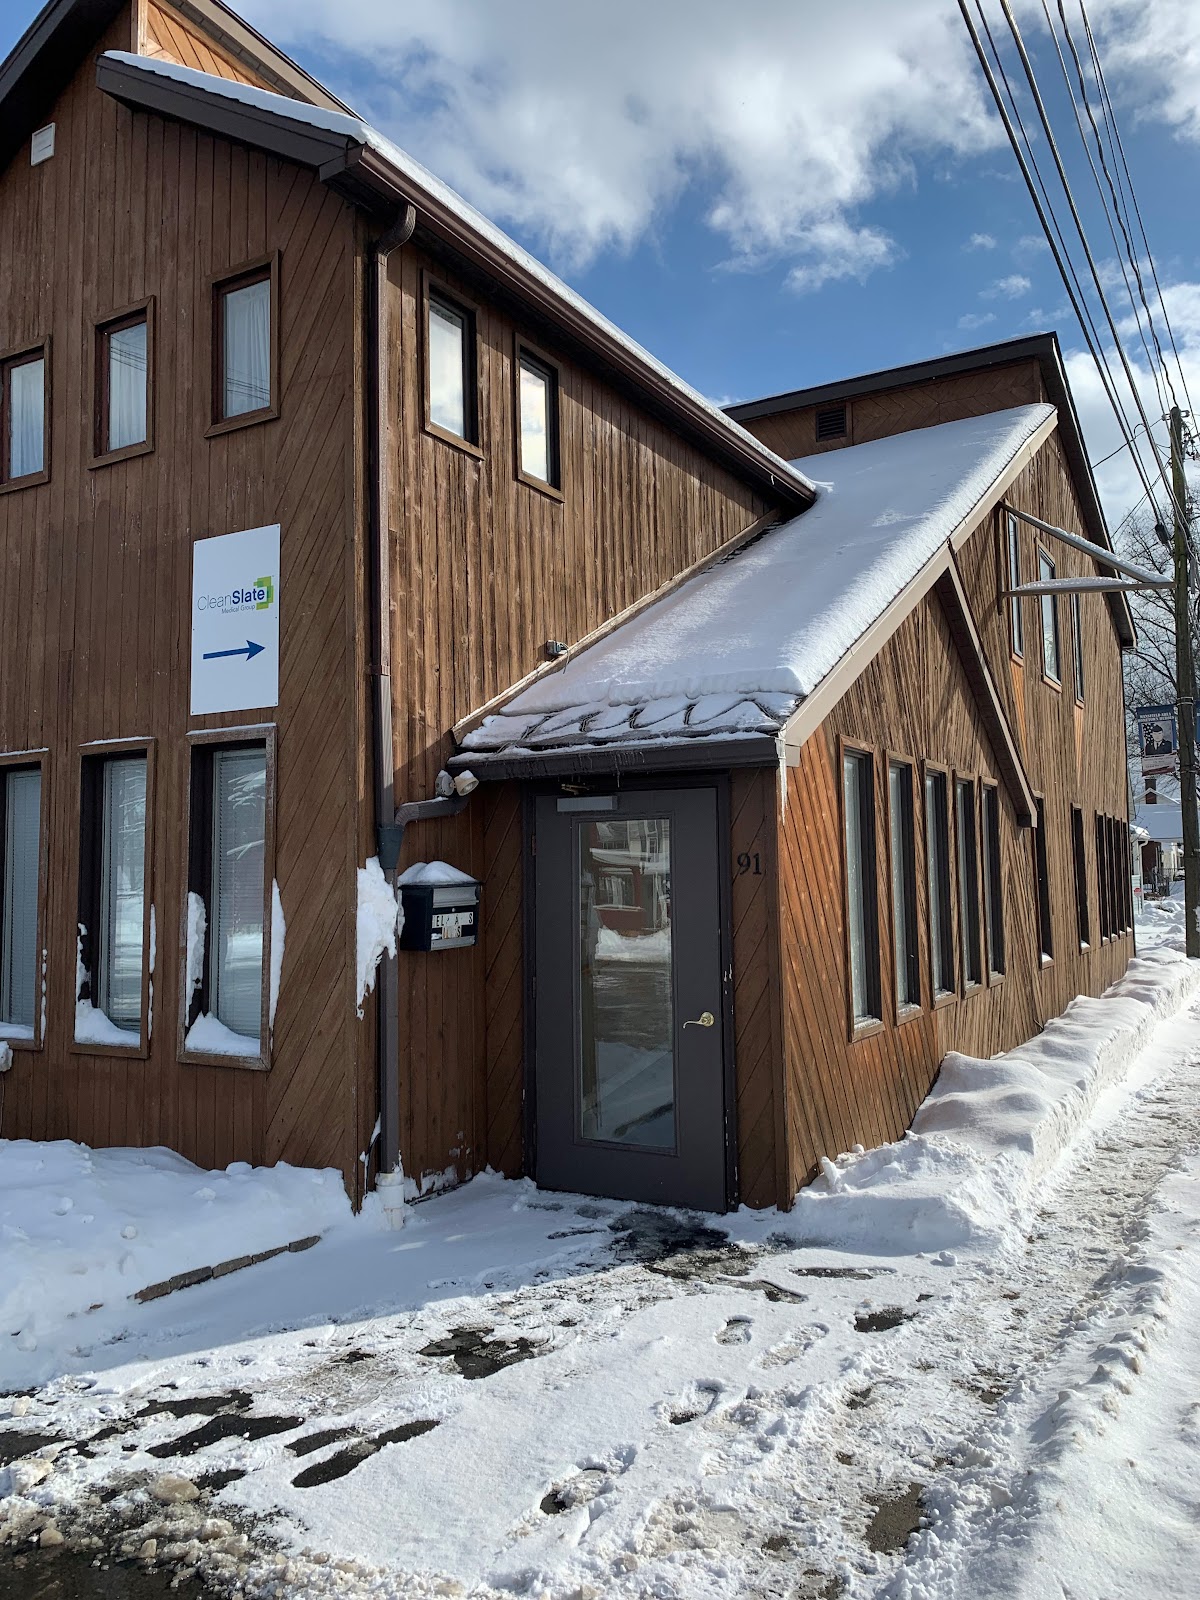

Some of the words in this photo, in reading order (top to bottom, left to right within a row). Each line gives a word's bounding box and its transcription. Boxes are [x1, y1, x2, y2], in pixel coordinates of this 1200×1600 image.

[198, 588, 265, 611] CleanSlate
[221, 605, 240, 614] Medical
[240, 604, 256, 612] Group
[737, 853, 762, 875] 91
